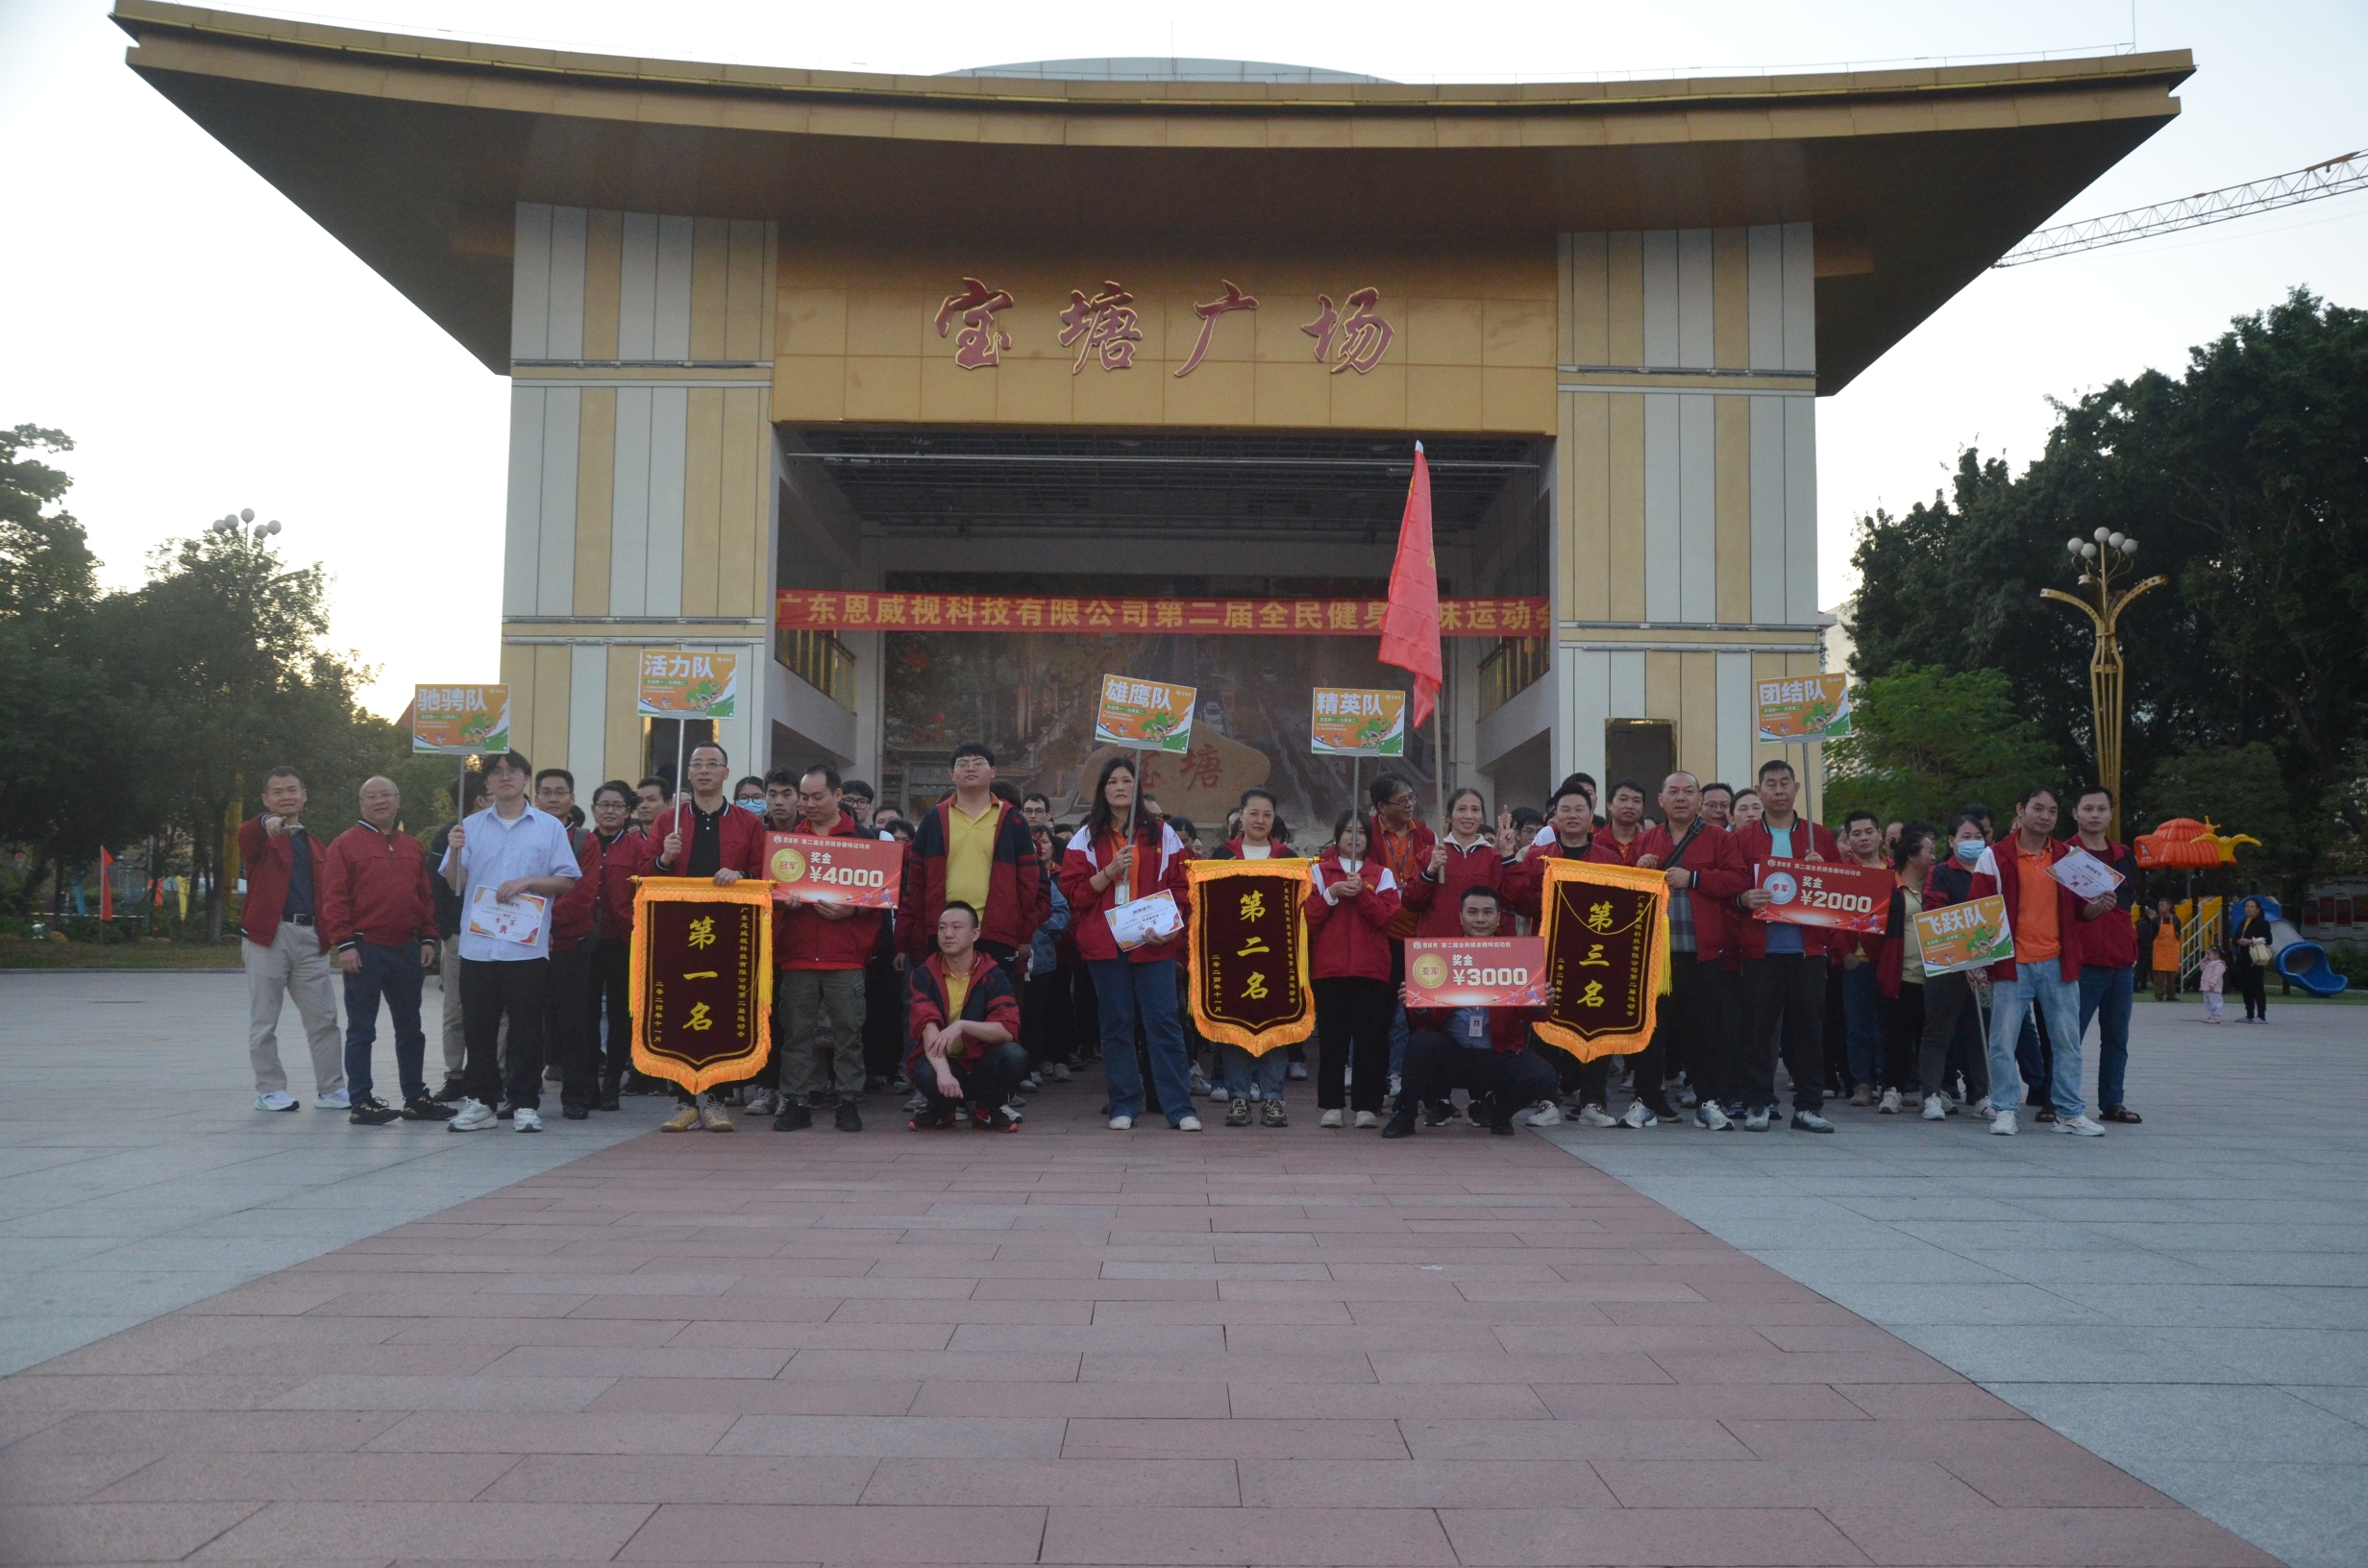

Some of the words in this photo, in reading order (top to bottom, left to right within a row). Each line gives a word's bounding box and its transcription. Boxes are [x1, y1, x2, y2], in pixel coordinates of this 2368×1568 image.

[935, 277, 1394, 377] 宝塘广场
[776, 593, 1549, 629] 广东恩威视科技有限公司第二届全民健身味运动
[644, 654, 715, 678] 活力队
[417, 688, 488, 712] 驰骋队
[1105, 679, 1172, 711] 雄鹰队
[1759, 678, 1827, 705] 团结队
[1317, 692, 1384, 716] 精英队
[779, 860, 797, 870] 冠军
[810, 851, 832, 865] 奖金
[809, 866, 884, 888] ¥4000
[1772, 883, 1789, 893] 季军
[1802, 875, 1823, 889] 奖金
[1800, 889, 1872, 913] ¥2000
[1918, 904, 1987, 935] 飞跃队
[1237, 890, 1270, 999] 第二名
[1576, 900, 1614, 1007] 第三名
[1421, 967, 1440, 976] 亚军
[1452, 954, 1473, 967] 奖金
[682, 916, 718, 1031] 第一名
[1453, 968, 1528, 986] ¥3000
